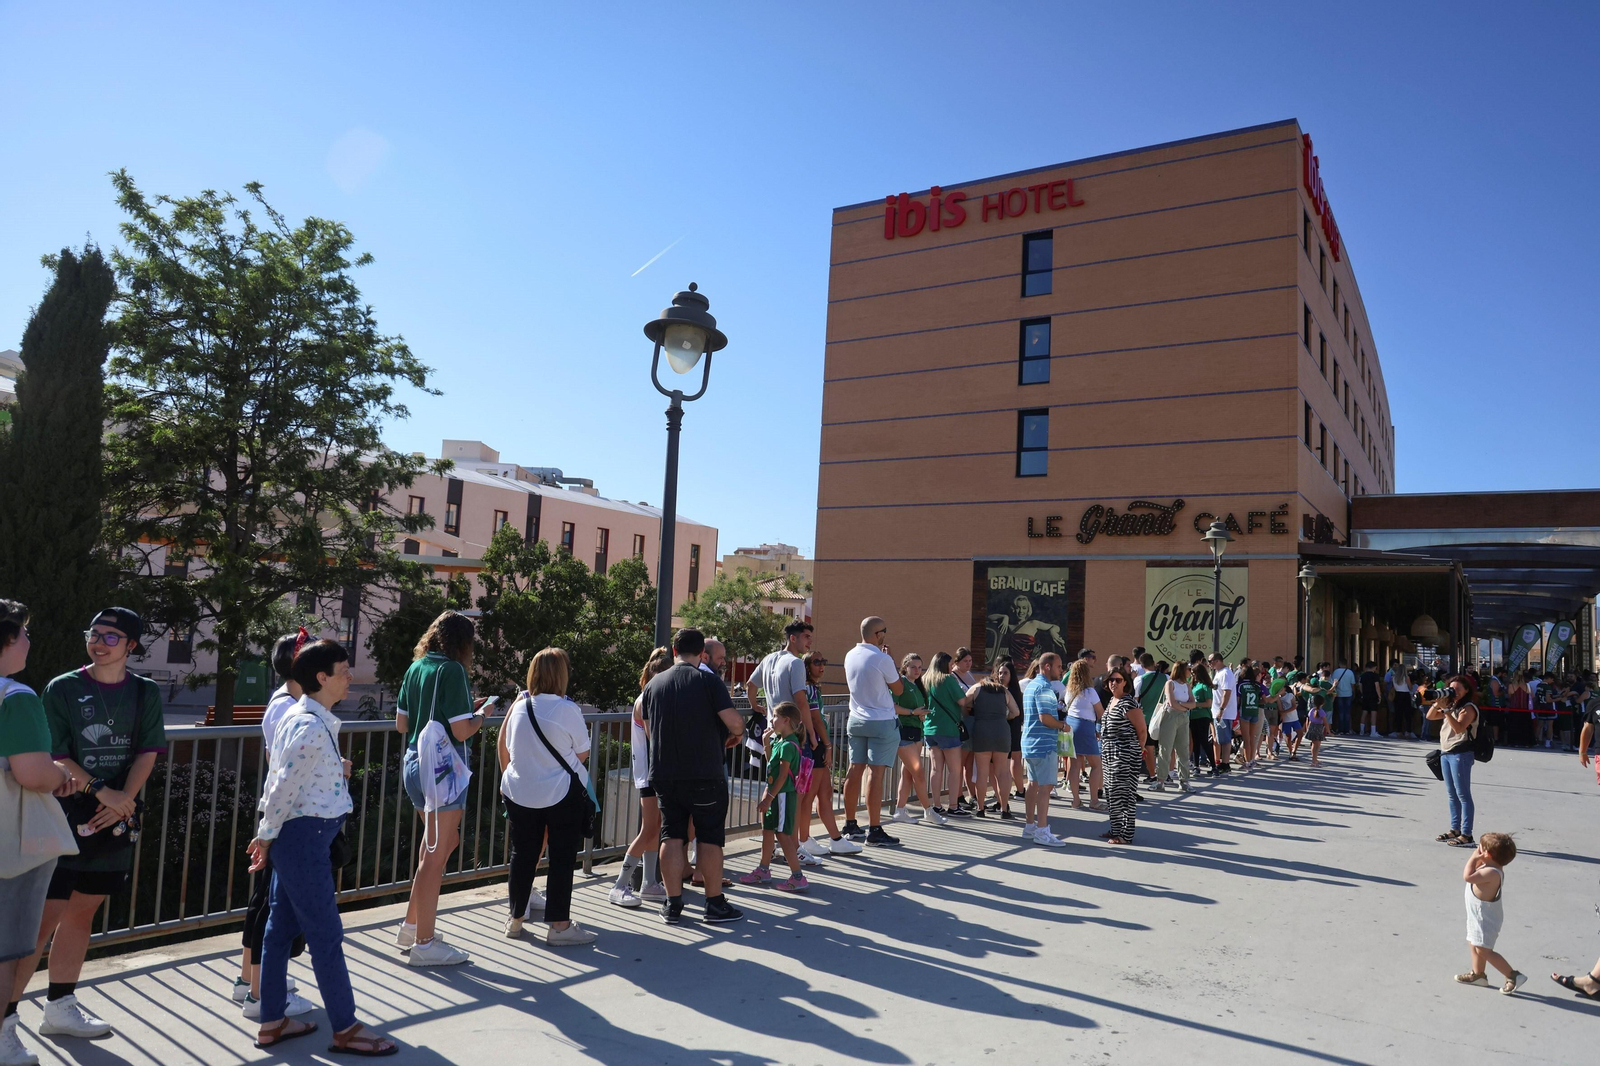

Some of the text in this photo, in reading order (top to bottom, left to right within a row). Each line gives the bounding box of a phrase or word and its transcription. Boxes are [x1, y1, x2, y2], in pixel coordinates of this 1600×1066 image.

[884, 178, 1085, 240] ibis HOTEL
[1028, 515, 1062, 538] LE
[1076, 499, 1185, 544] Grand
[1194, 503, 1288, 535] CAFÉ
[990, 576, 1066, 597] GRAND CAFÉ
[1187, 589, 1202, 597] LE
[1147, 595, 1245, 641] Grand
[1169, 632, 1215, 642] CAF
[1220, 632, 1239, 657] RIENDS
[1246, 692, 1256, 705] 12
[110, 734, 131, 745] Unic
